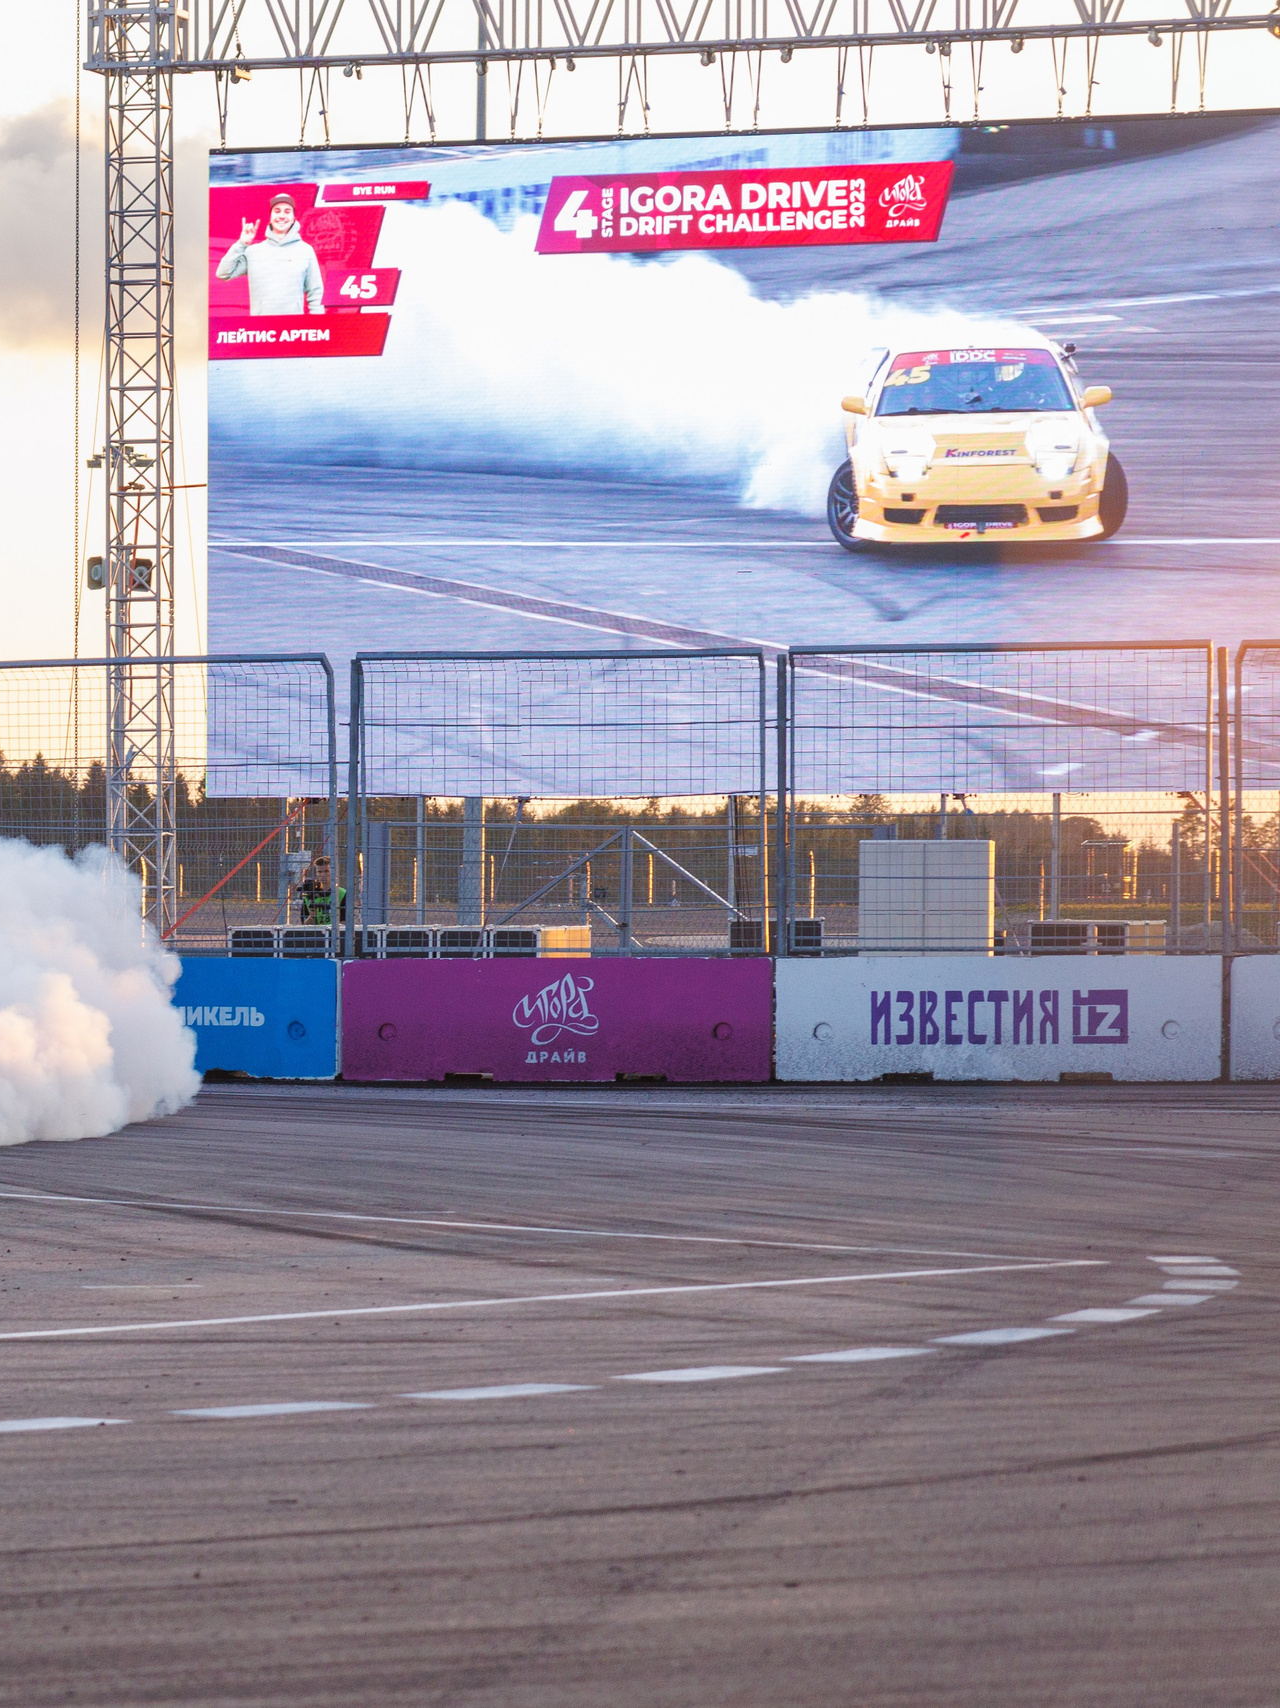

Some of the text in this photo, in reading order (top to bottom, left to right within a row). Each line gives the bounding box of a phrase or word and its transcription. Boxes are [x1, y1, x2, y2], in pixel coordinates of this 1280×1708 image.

[352, 185, 396, 195] BYE RUN
[620, 180, 848, 214] IGORA DRIVE
[554, 190, 598, 238] 4
[601, 188, 614, 238] STAGE
[849, 178, 865, 228] 2023
[620, 209, 848, 236] DRIFT CHALLENGE
[885, 217, 920, 228] ДРАЙВ
[340, 275, 378, 299] 45
[216, 328, 330, 343] ЛЕЙТИС АРТЕМ
[884, 365, 931, 388] 45
[870, 990, 1059, 1045] ИЗВЕСТИЯ
[525, 1048, 586, 1063] ДРАЙВ
